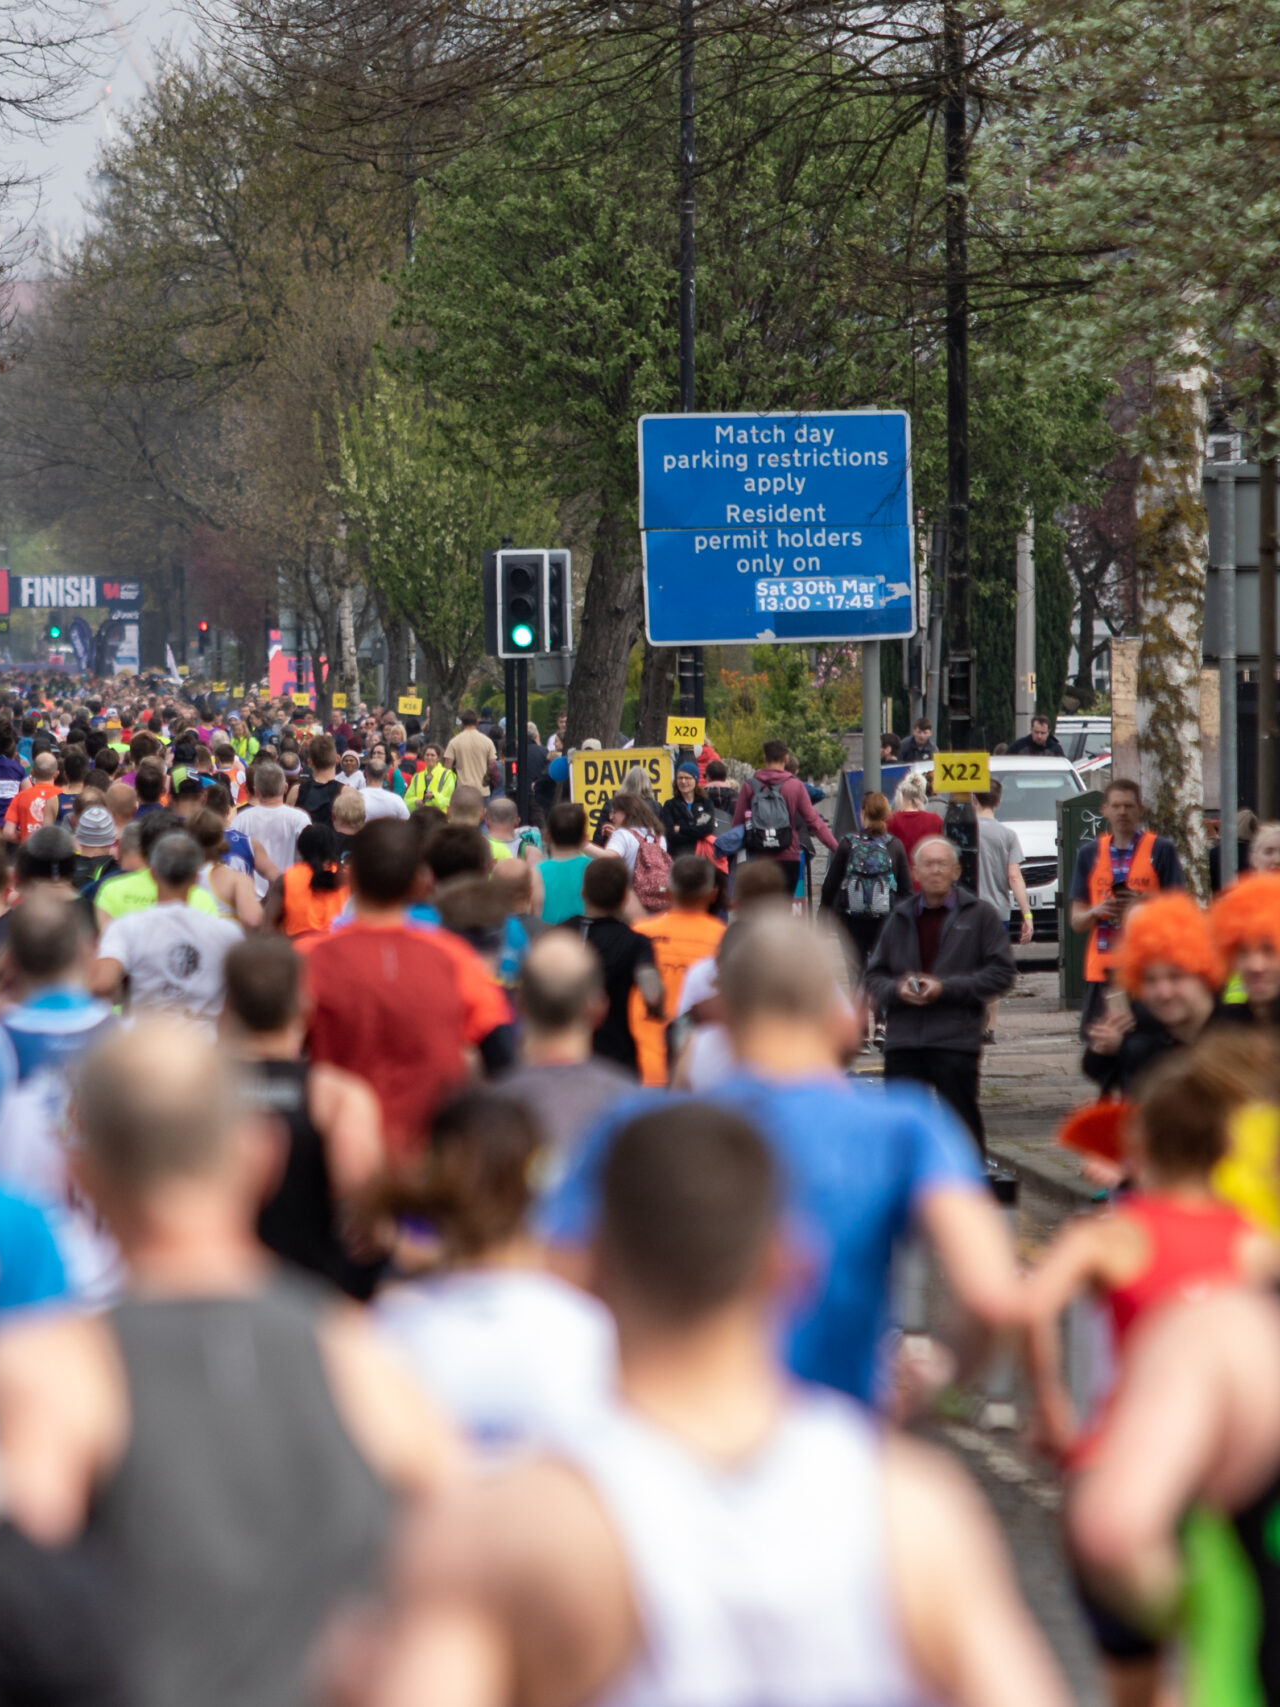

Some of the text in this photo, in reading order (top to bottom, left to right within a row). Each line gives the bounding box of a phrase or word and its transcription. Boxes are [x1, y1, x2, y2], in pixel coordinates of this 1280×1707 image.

[715, 424, 835, 446] Match day
[663, 448, 889, 472] parking restrictions
[744, 473, 806, 495] apply
[726, 503, 826, 523] Resident
[694, 528, 863, 553] permit holders
[736, 554, 821, 576] only on
[21, 576, 97, 608] FINISH
[756, 580, 876, 597] Sat 30th Mar
[758, 596, 811, 611] 13:00
[827, 595, 874, 609] 17:45
[674, 726, 698, 737] X20
[941, 763, 981, 781] X22
